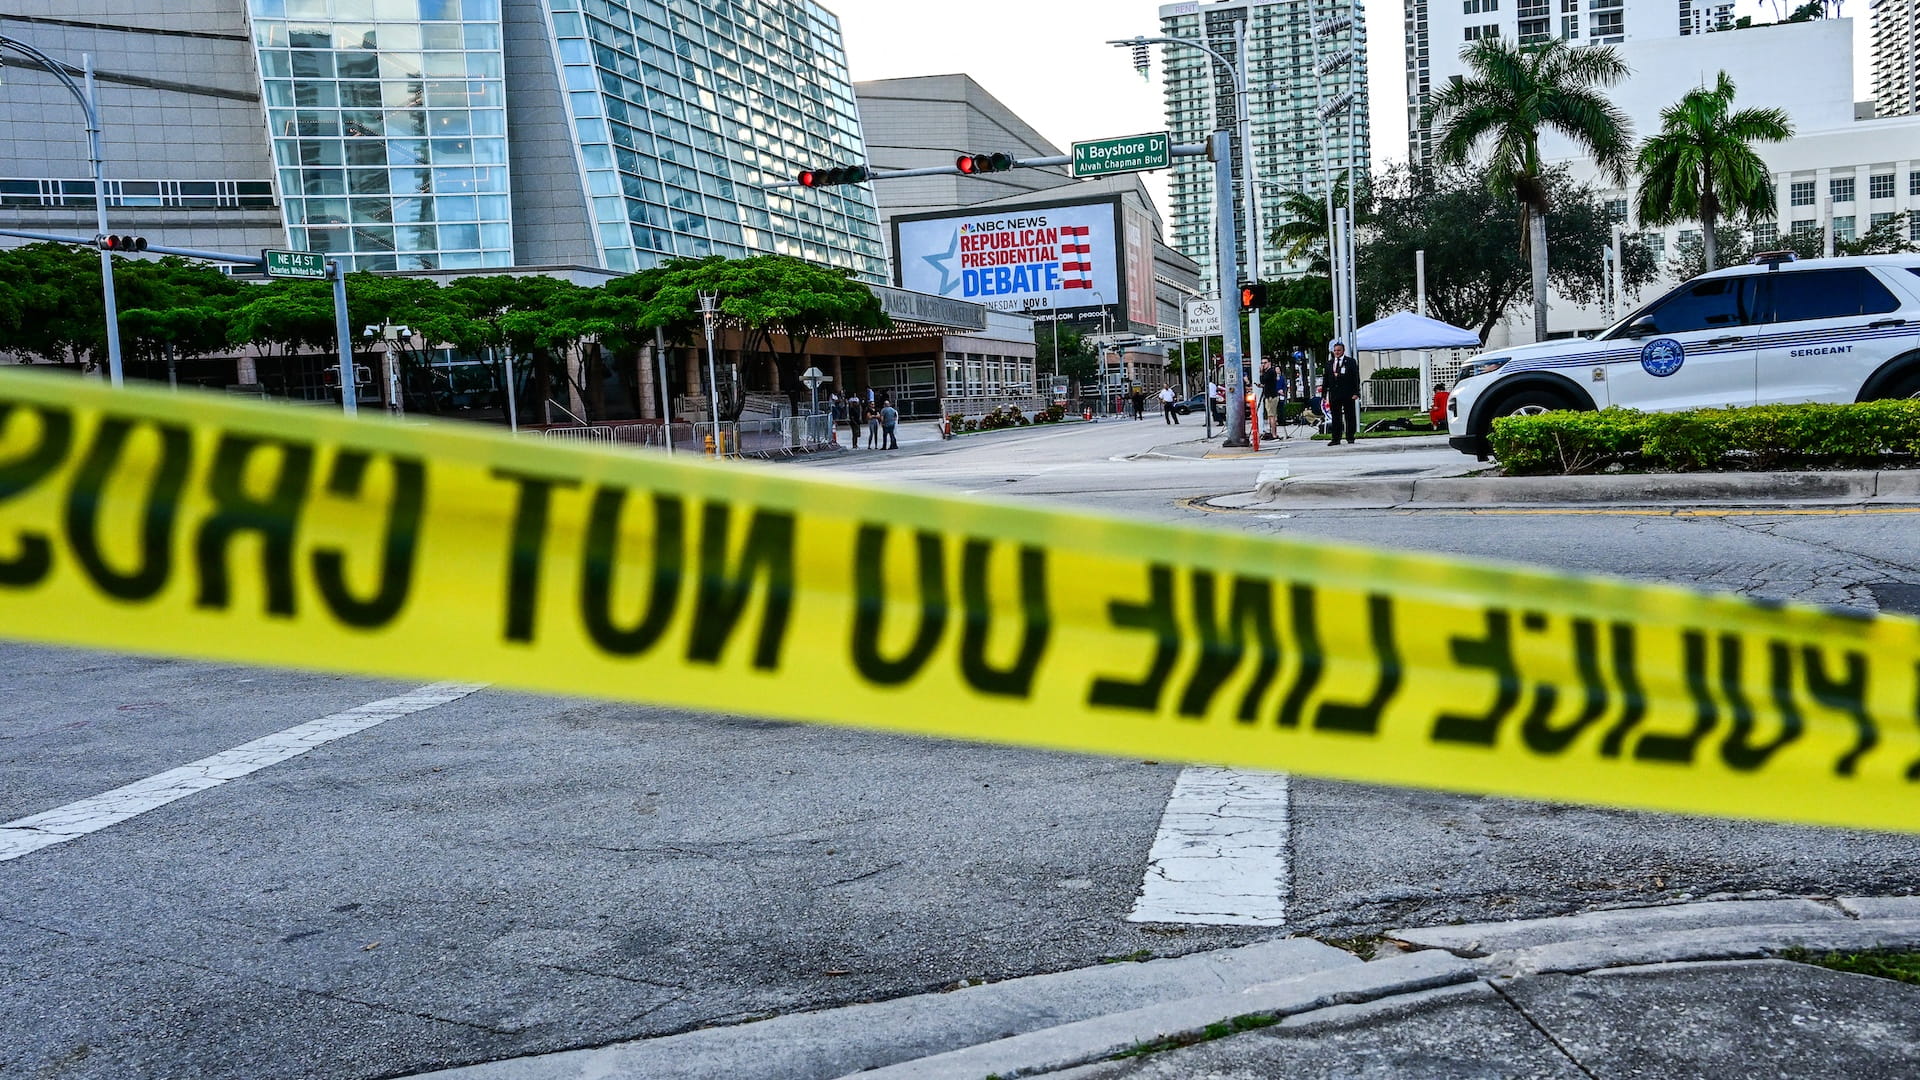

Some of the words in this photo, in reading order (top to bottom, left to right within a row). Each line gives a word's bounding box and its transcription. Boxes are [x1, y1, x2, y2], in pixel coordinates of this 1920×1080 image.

[1176, 5, 1196, 14] RENT
[1076, 147, 1085, 160] N
[1089, 143, 1145, 159] Bayshore
[1150, 139, 1165, 152] Dr
[1080, 161, 1102, 172] Alvah
[1104, 158, 1142, 169] Chapman
[1145, 154, 1163, 165] Blvd
[976, 220, 1004, 232] NBC
[1007, 216, 1048, 230] NEWS
[960, 227, 1058, 252] REPUBLICAN
[277, 254, 289, 264] NE
[291, 254, 302, 266] 14
[304, 256, 314, 266] ST
[961, 246, 1058, 268] PRESIDENTIAL
[962, 262, 1060, 297] DEBATE
[1023, 297, 1039, 308] NOV
[1042, 297, 1048, 307] 8
[1079, 311, 1107, 321] peacock
[1790, 345, 1853, 358] SERGEANT
